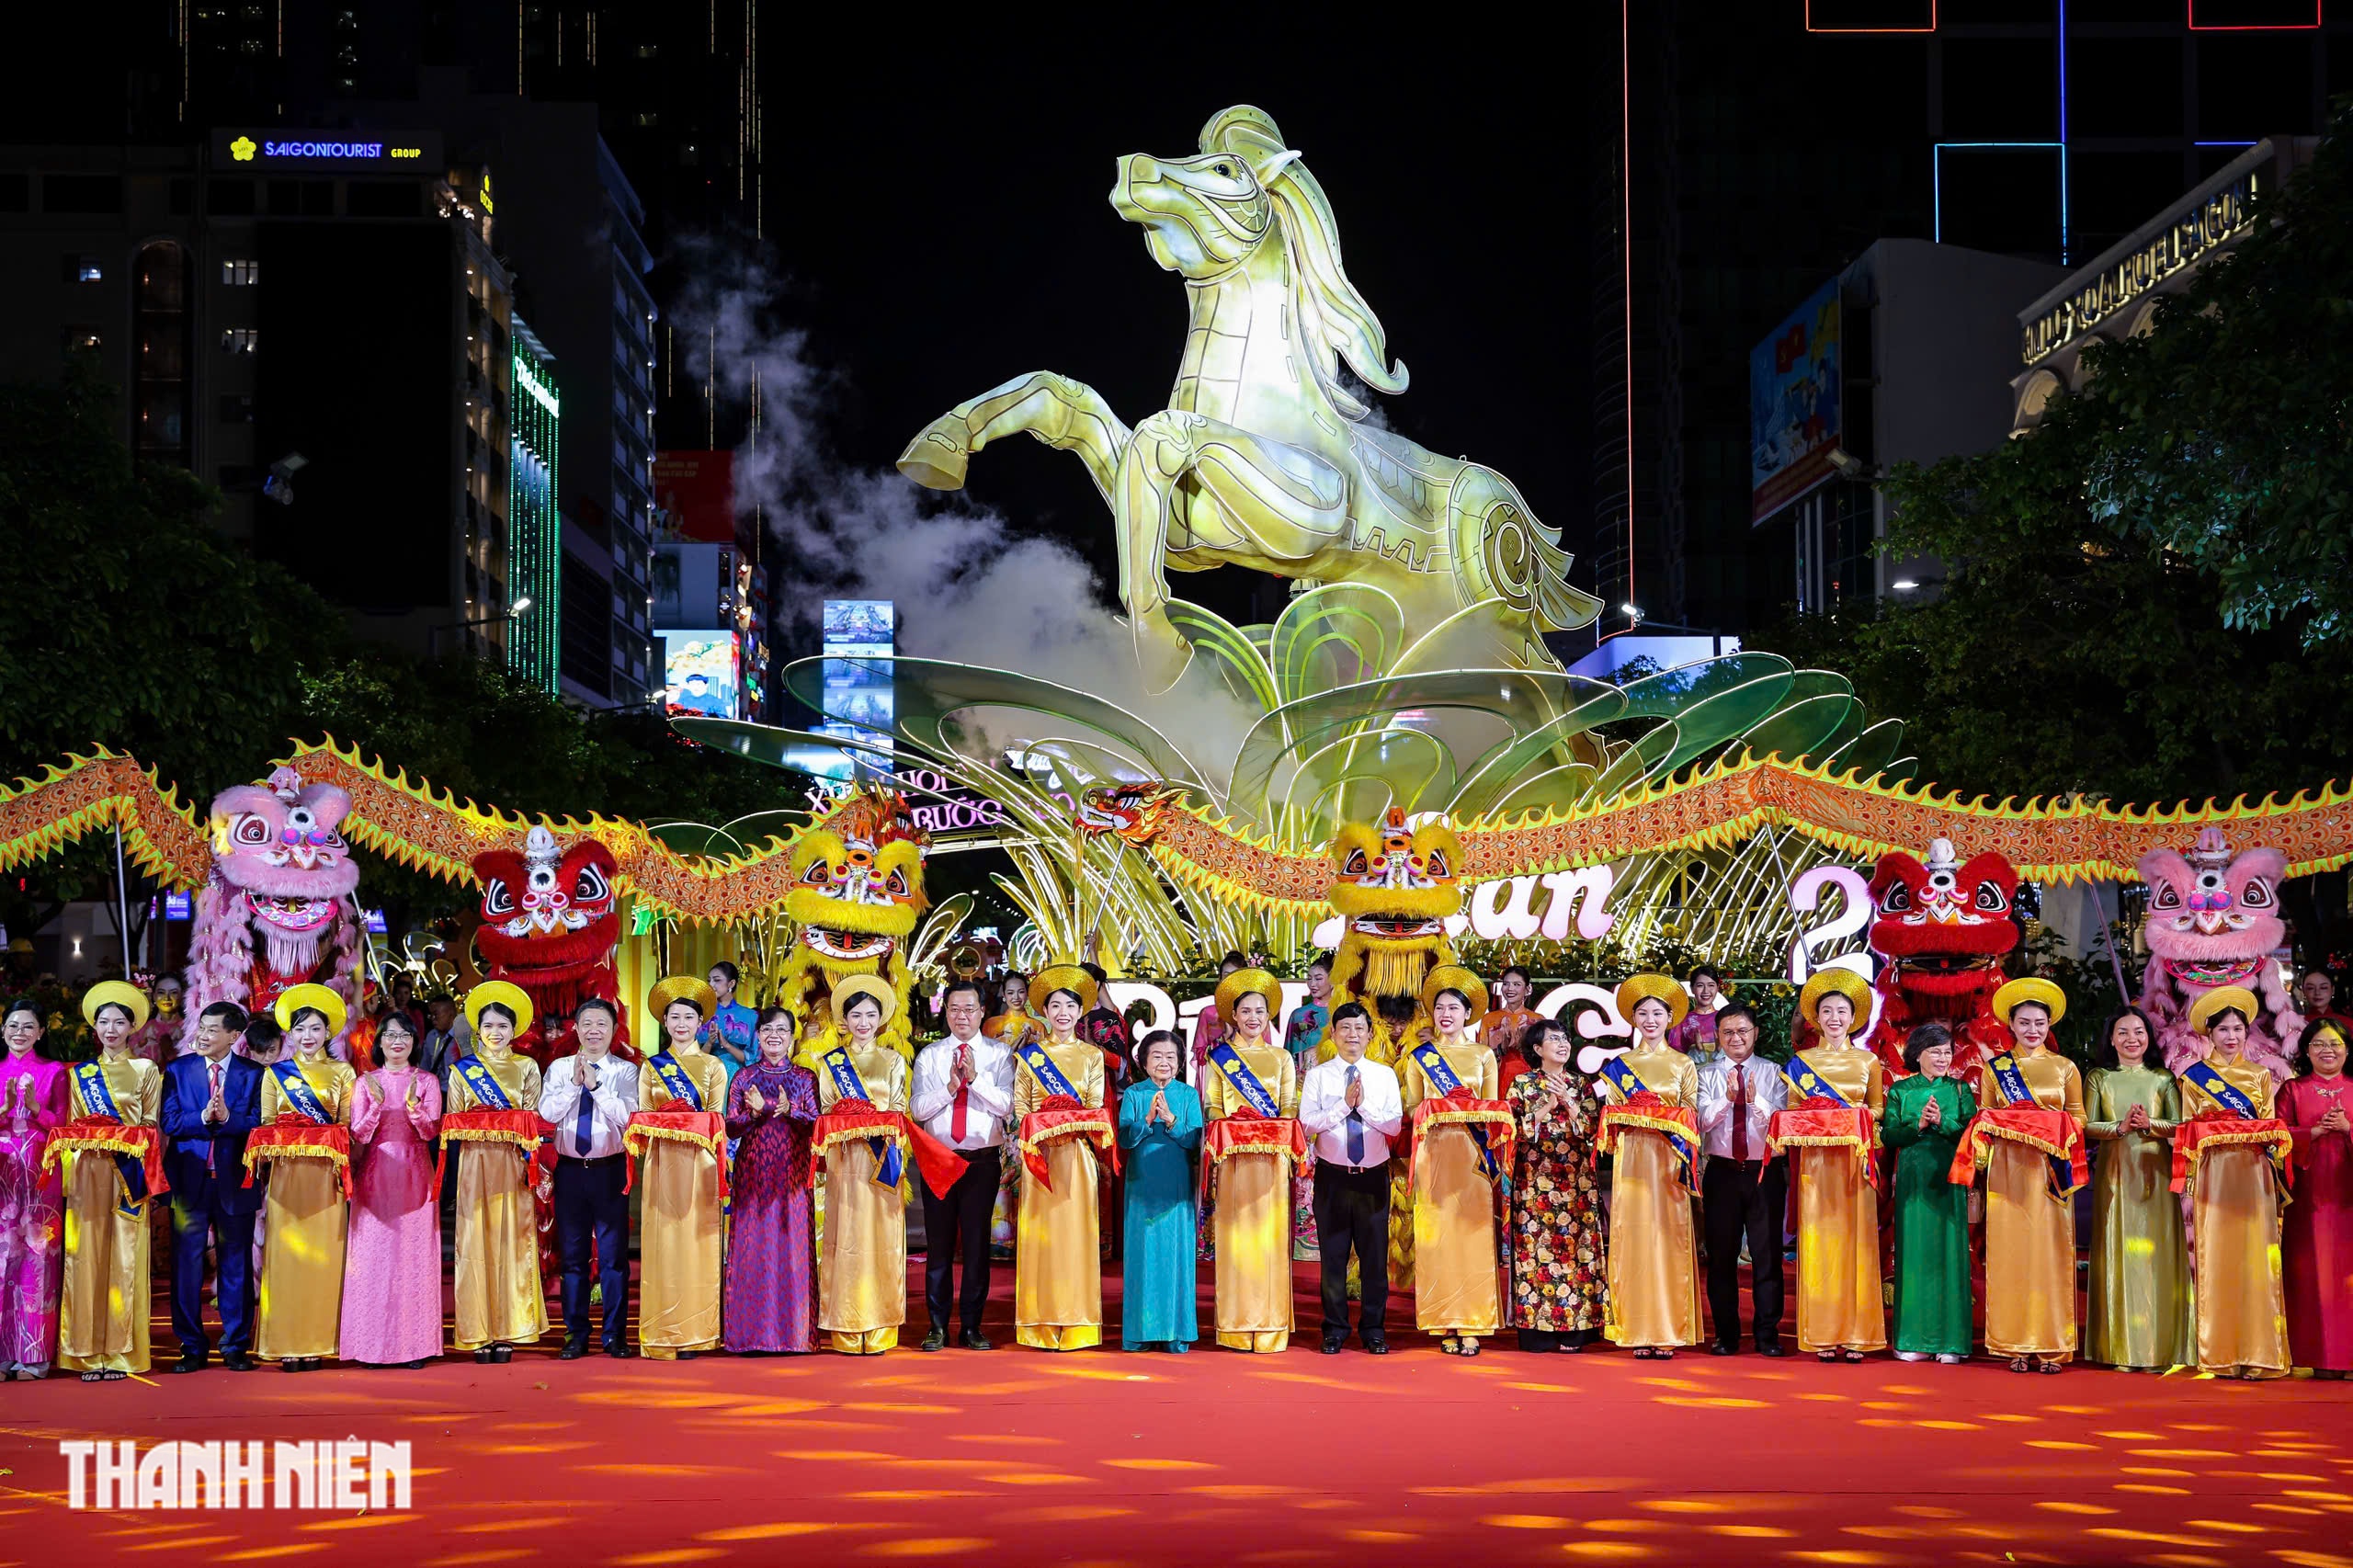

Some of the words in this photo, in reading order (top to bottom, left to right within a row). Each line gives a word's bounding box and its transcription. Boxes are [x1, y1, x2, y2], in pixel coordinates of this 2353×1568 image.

[265, 142, 382, 158] SAIGONTOURIST
[391, 148, 421, 158] GROUP
[87, 1077, 110, 1116] SAIGONTO
[295, 1089, 327, 1124] SAIGONTO
